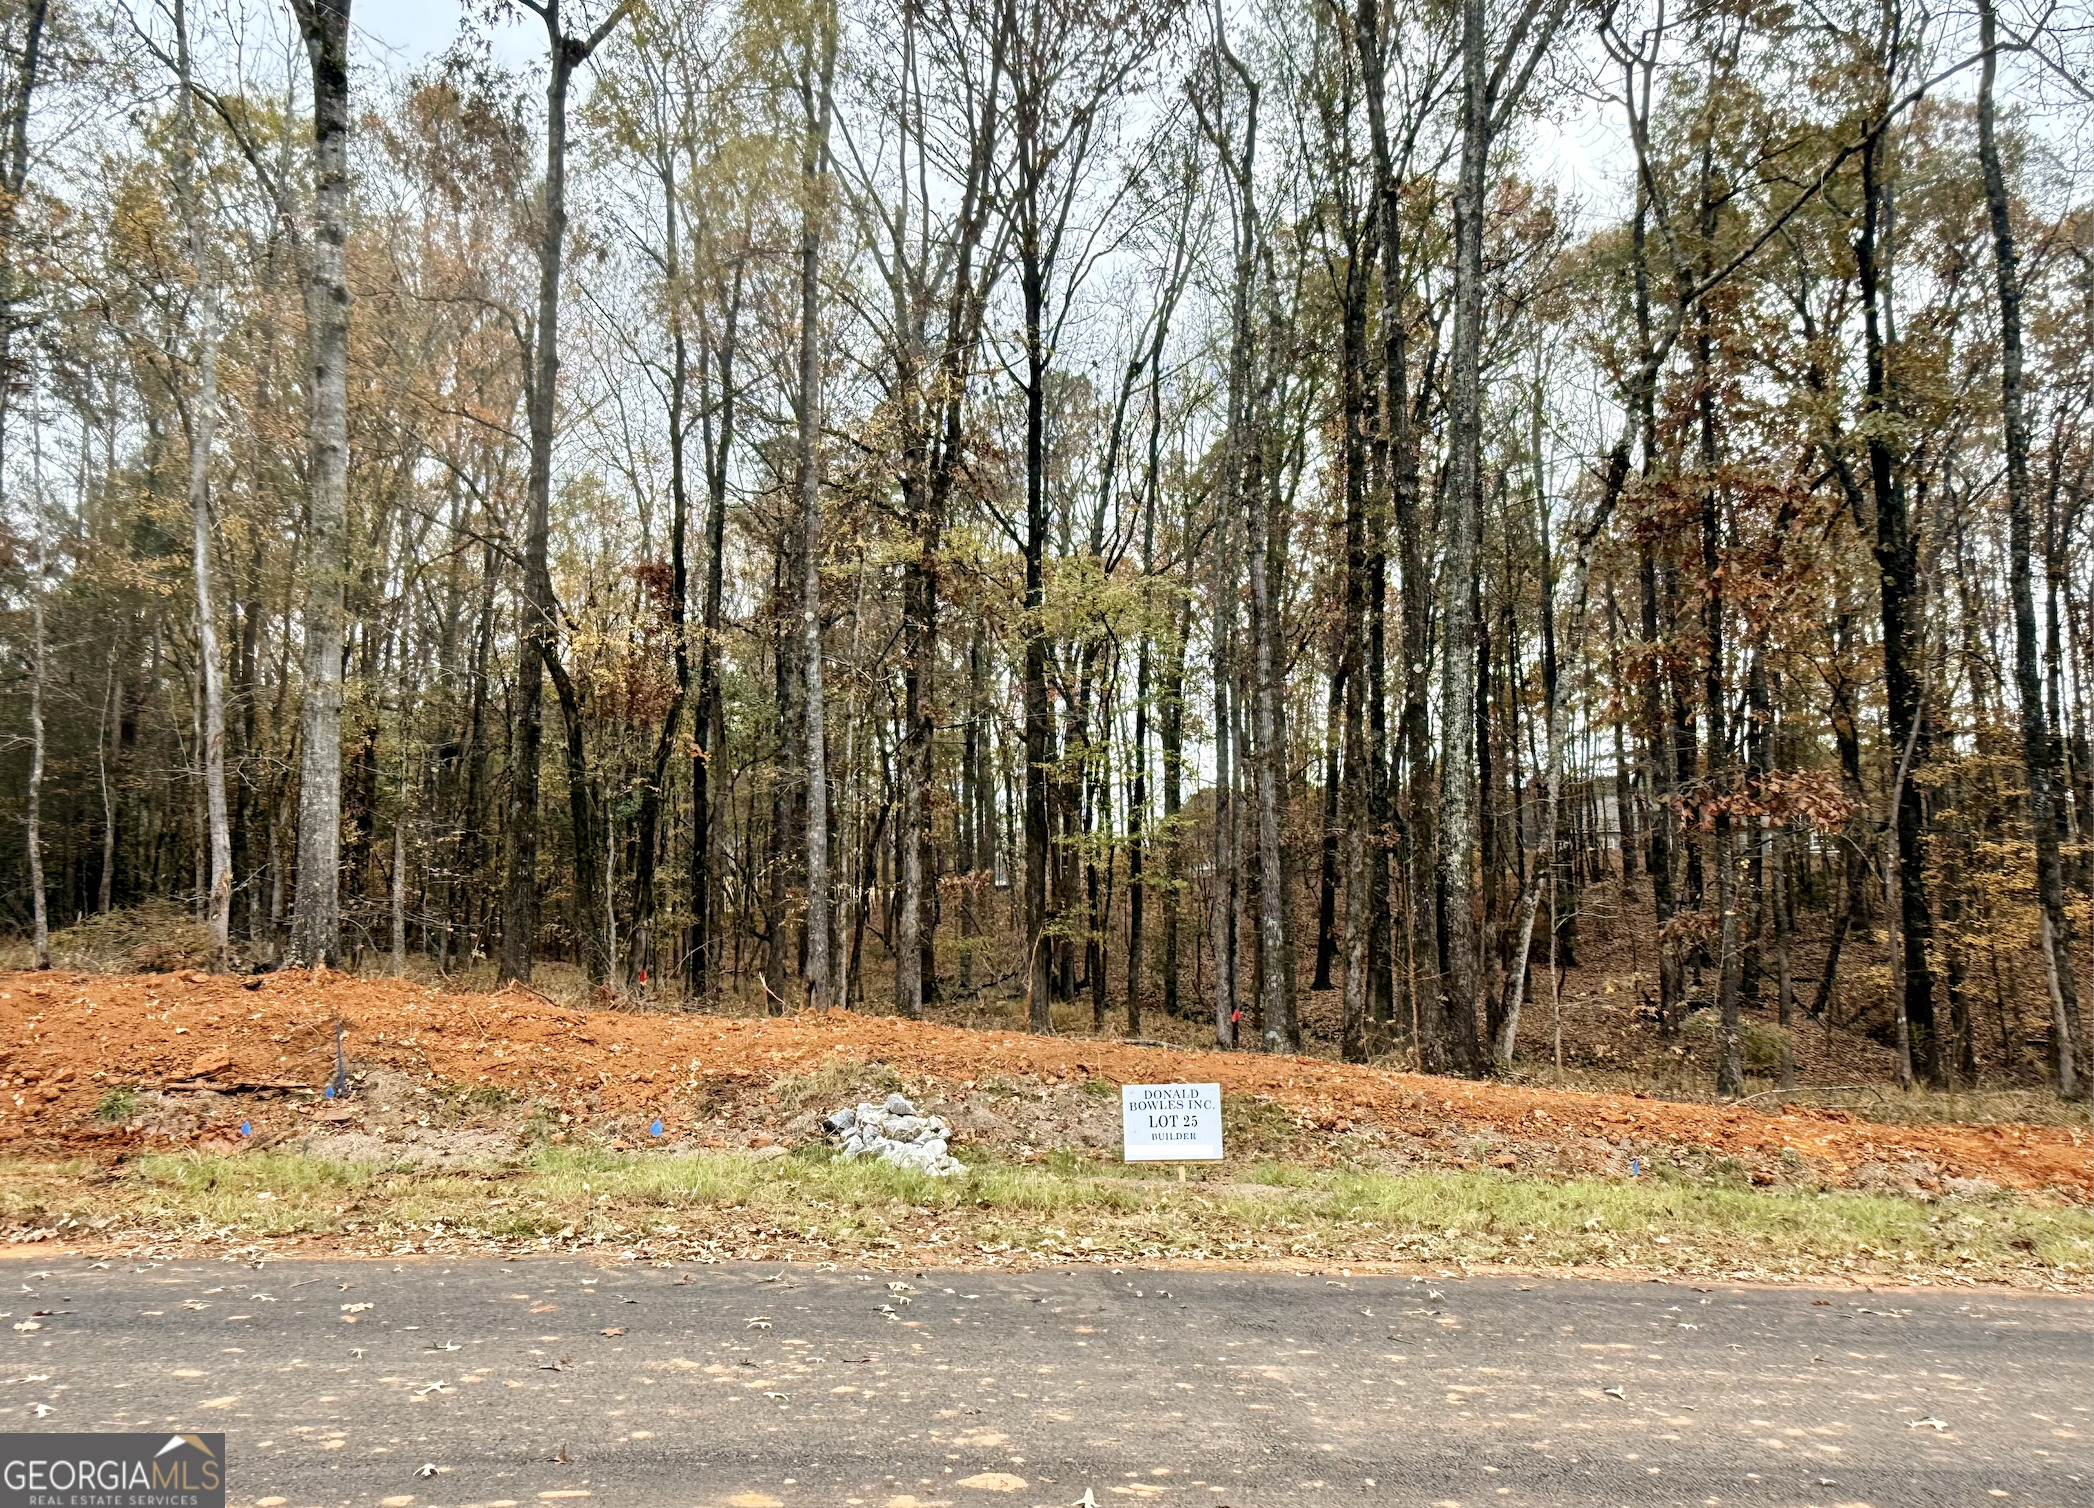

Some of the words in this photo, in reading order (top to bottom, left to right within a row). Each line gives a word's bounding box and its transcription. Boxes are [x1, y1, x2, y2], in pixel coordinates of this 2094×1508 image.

[1144, 1089, 1199, 1100] DONALD
[1129, 1100, 1184, 1111] BOWLES
[1188, 1099, 1216, 1110] INC.
[1149, 1115, 1179, 1128] LOT
[1183, 1115, 1198, 1127] 25
[1151, 1132, 1197, 1141] BUILDER
